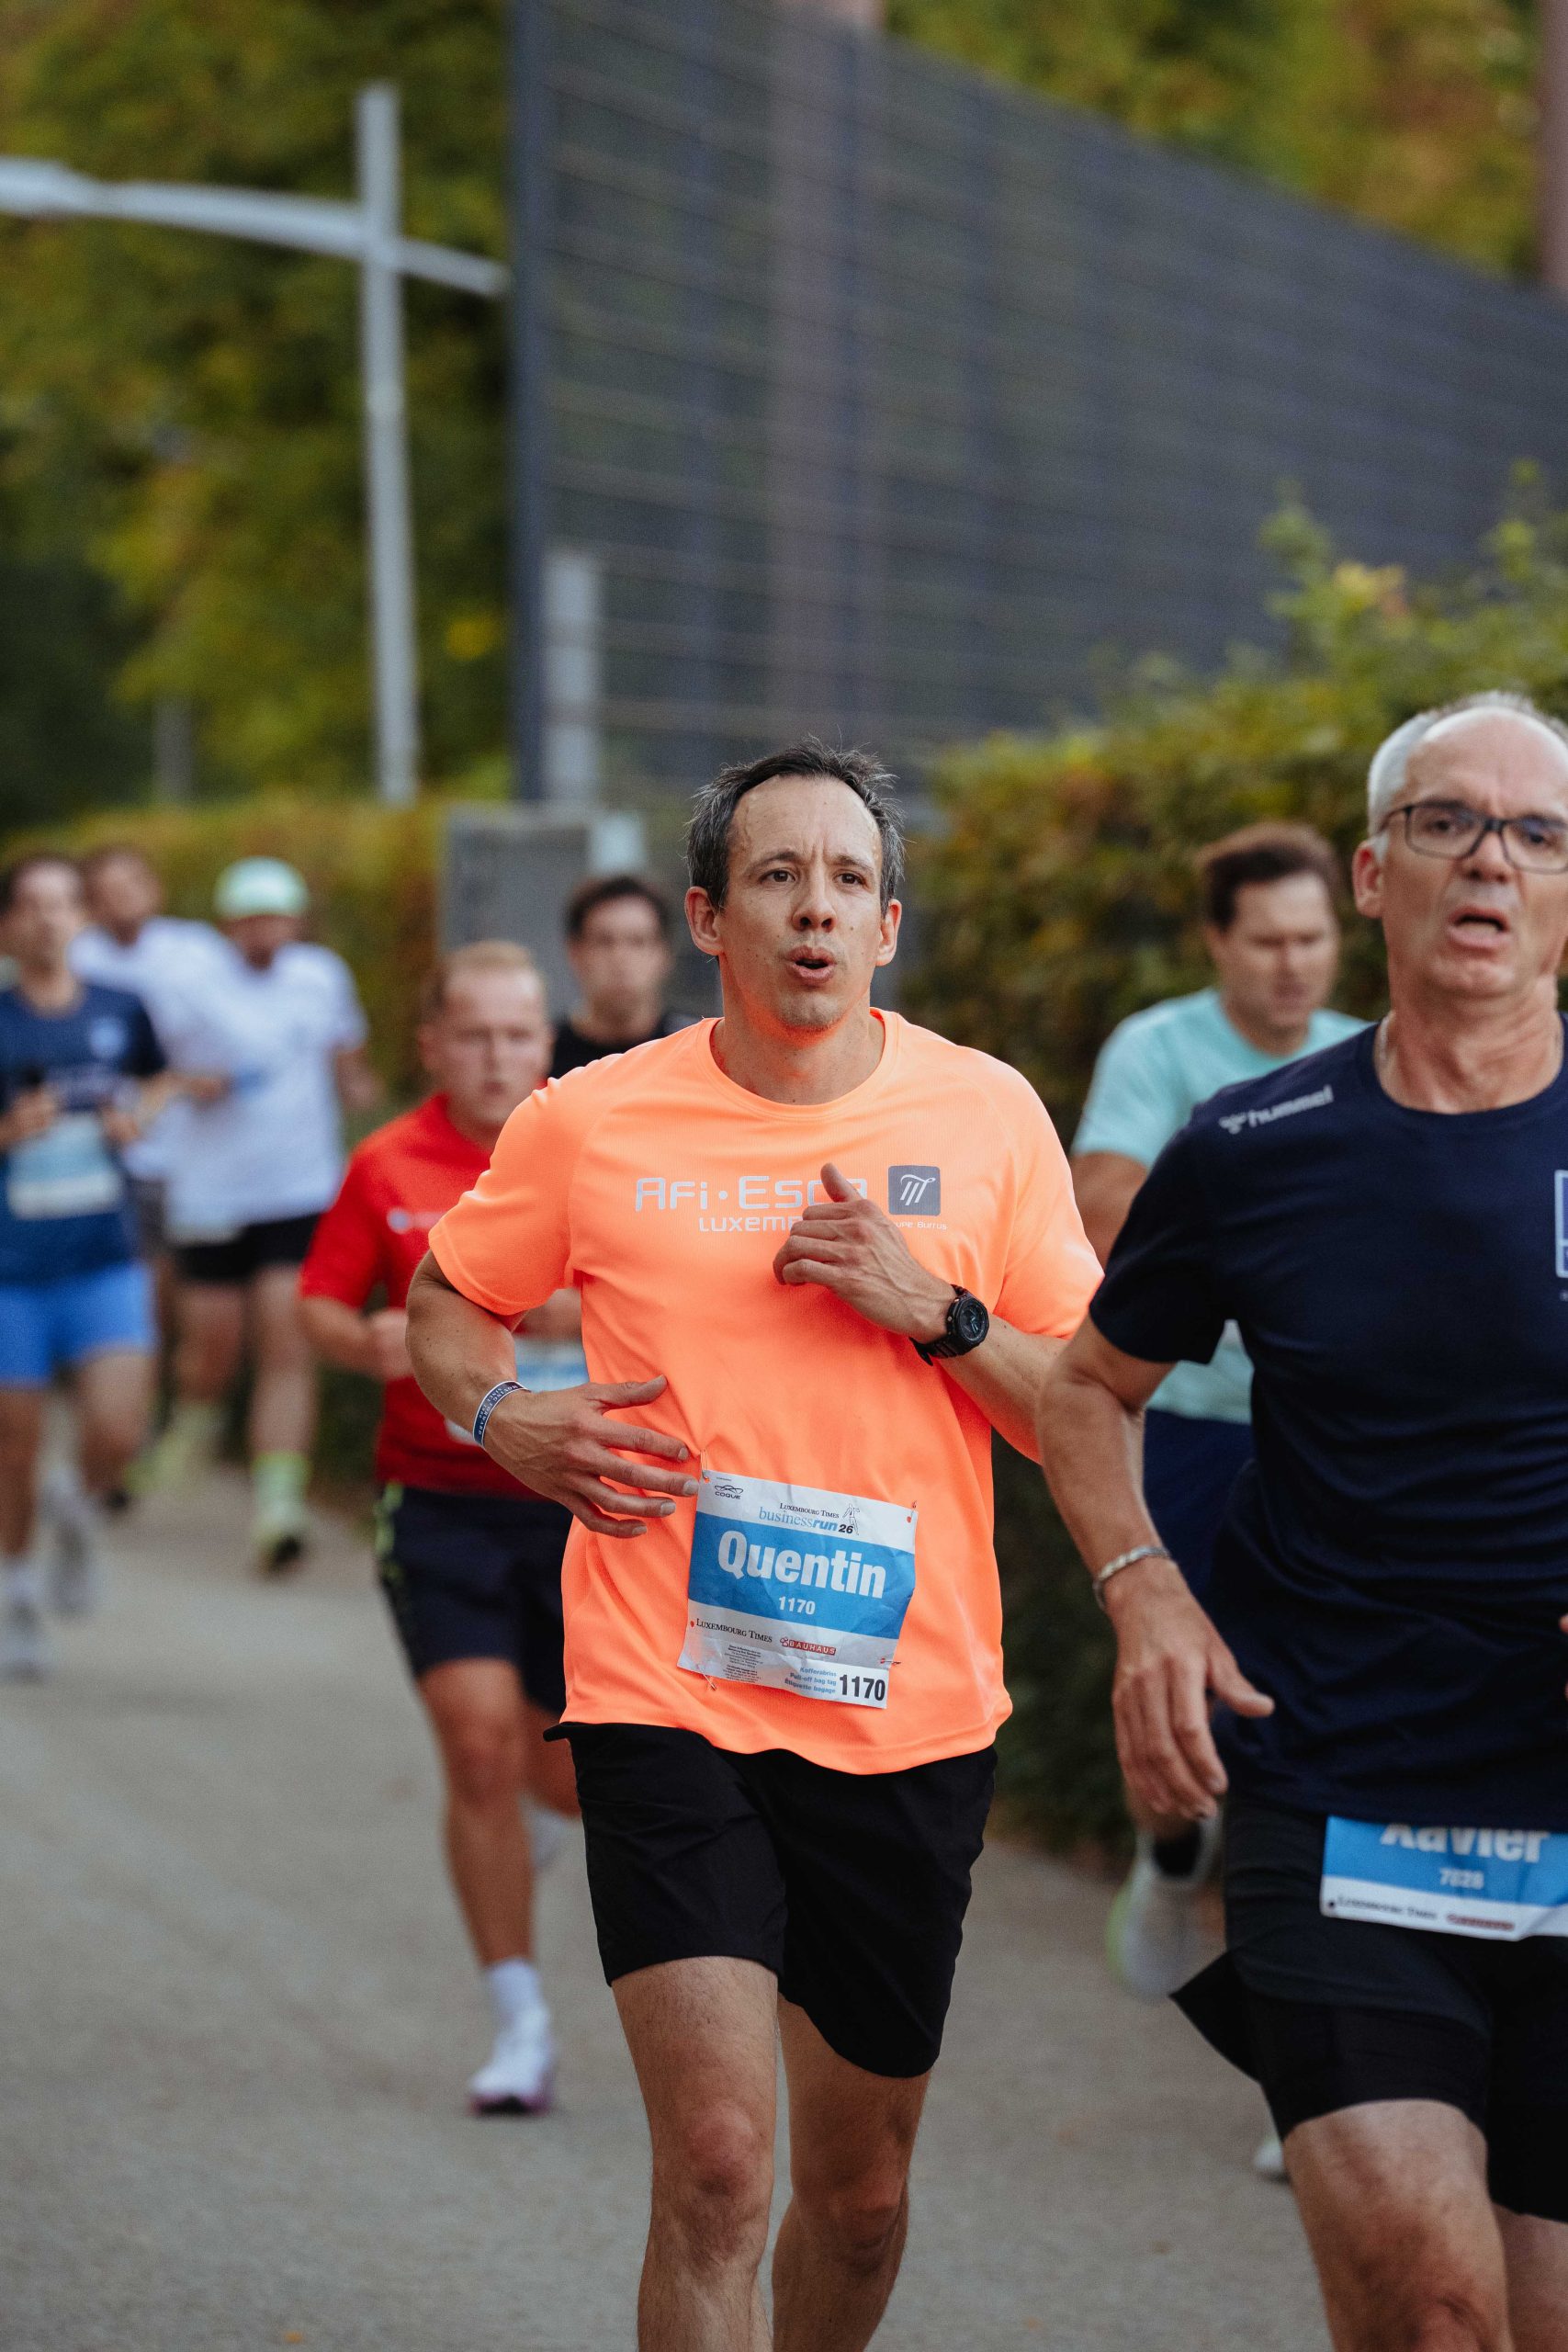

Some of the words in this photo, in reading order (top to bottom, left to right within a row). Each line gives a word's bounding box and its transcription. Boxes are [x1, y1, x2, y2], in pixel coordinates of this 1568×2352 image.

[715, 1491, 741, 1500] COQUE
[779, 1502, 820, 1516] LUXEMBOURG
[820, 1510, 840, 1519] TIMES
[838, 1523, 854, 1534] 26
[717, 1530, 886, 1600] Quentin
[778, 1596, 817, 1615] 1170
[696, 1618, 747, 1637] LUXEMBOURG
[748, 1630, 773, 1643] TIMES
[789, 1640, 836, 1655] BAUHAUS
[839, 1674, 886, 1702] 1170
